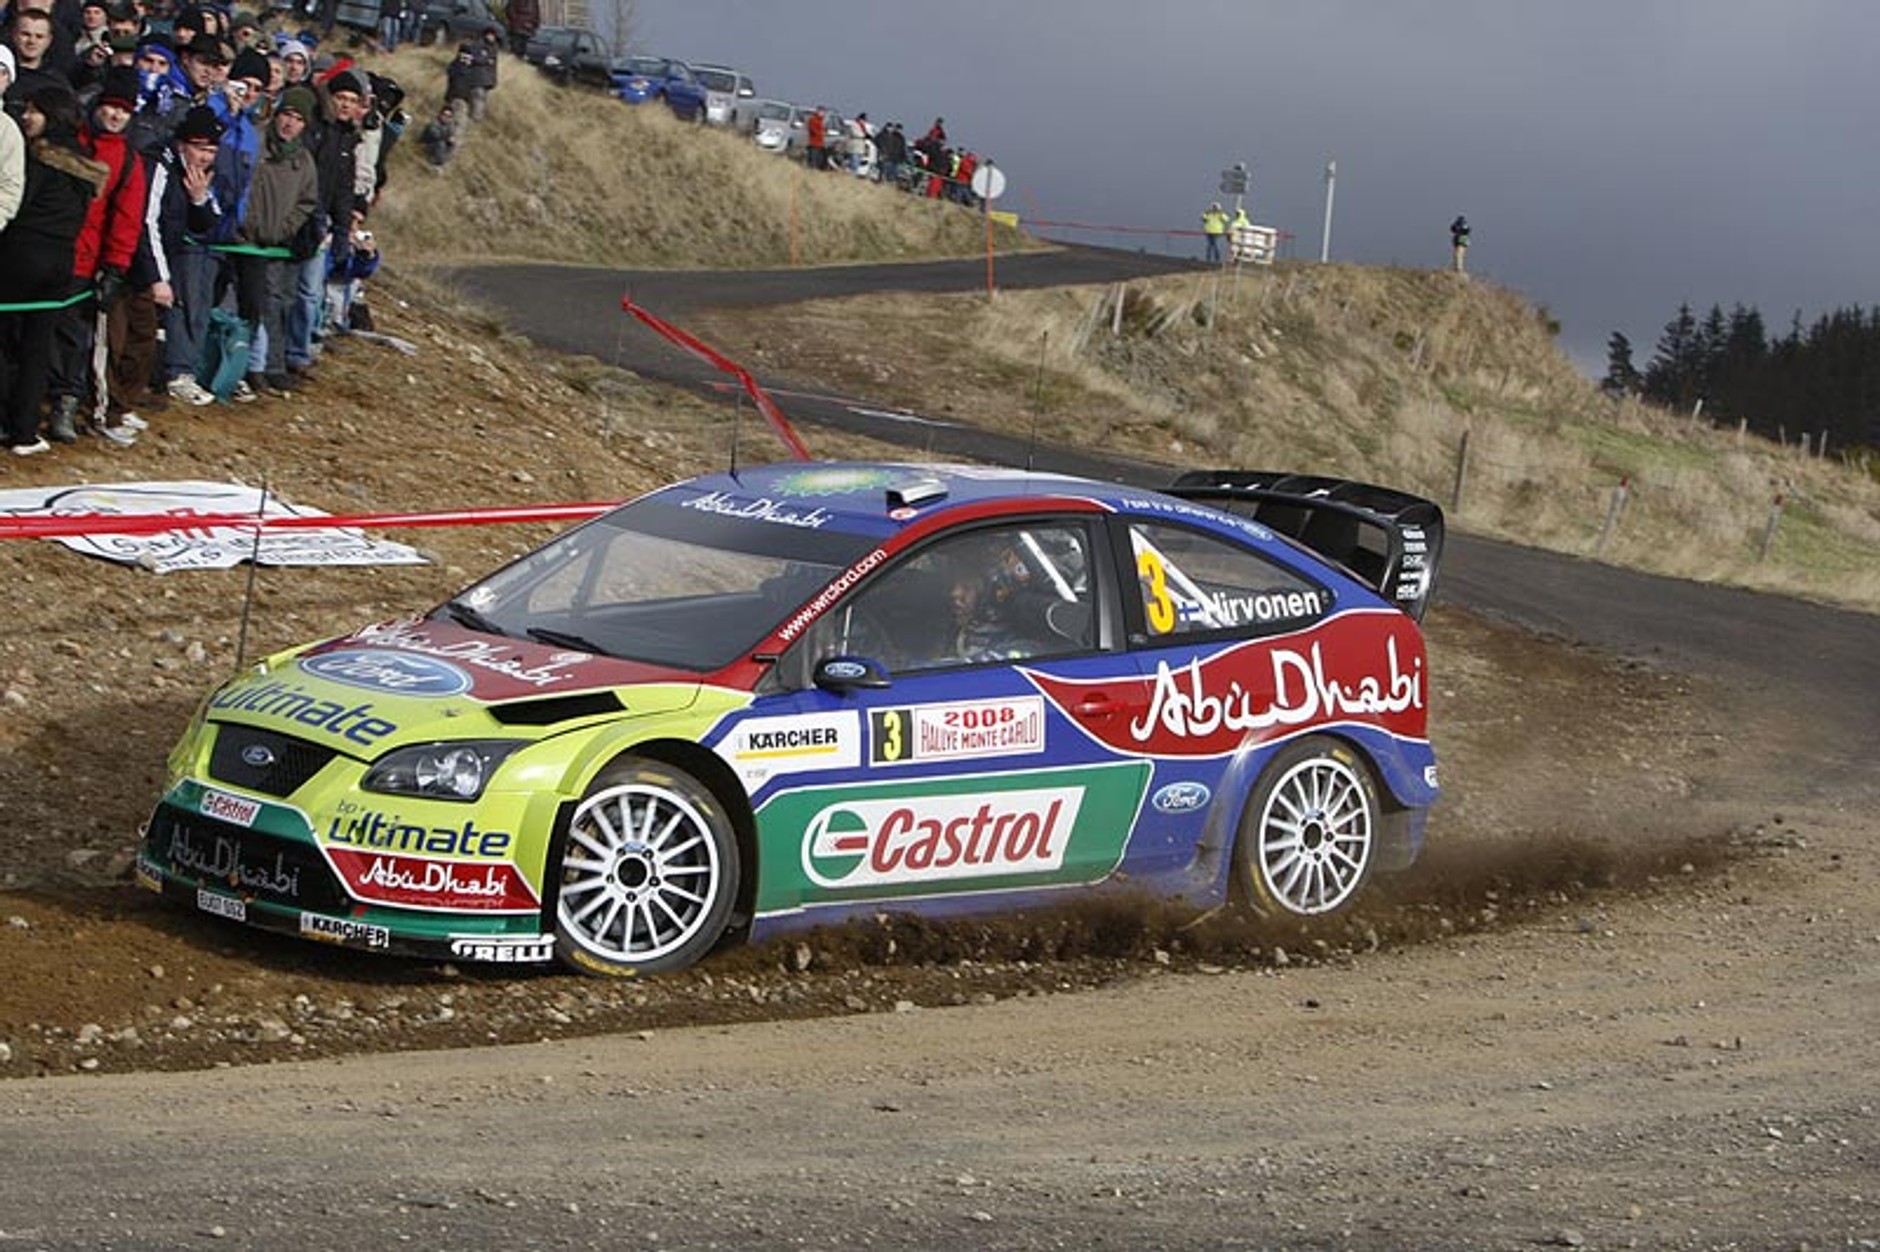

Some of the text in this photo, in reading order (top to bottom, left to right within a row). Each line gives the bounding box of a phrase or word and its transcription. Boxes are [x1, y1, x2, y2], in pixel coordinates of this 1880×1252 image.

[1136, 551, 1176, 635] 3
[1130, 634, 1424, 742] Abu Dhabi
[209, 680, 398, 746] ultimate
[883, 710, 902, 761] 3
[921, 712, 1038, 753] RALLYE MONTE CARLO
[944, 707, 1015, 729] 2008
[212, 795, 257, 824] Castrol
[328, 811, 511, 857] ultimate
[871, 799, 1063, 873] Castrol
[359, 857, 507, 897] Abu Dhabi
